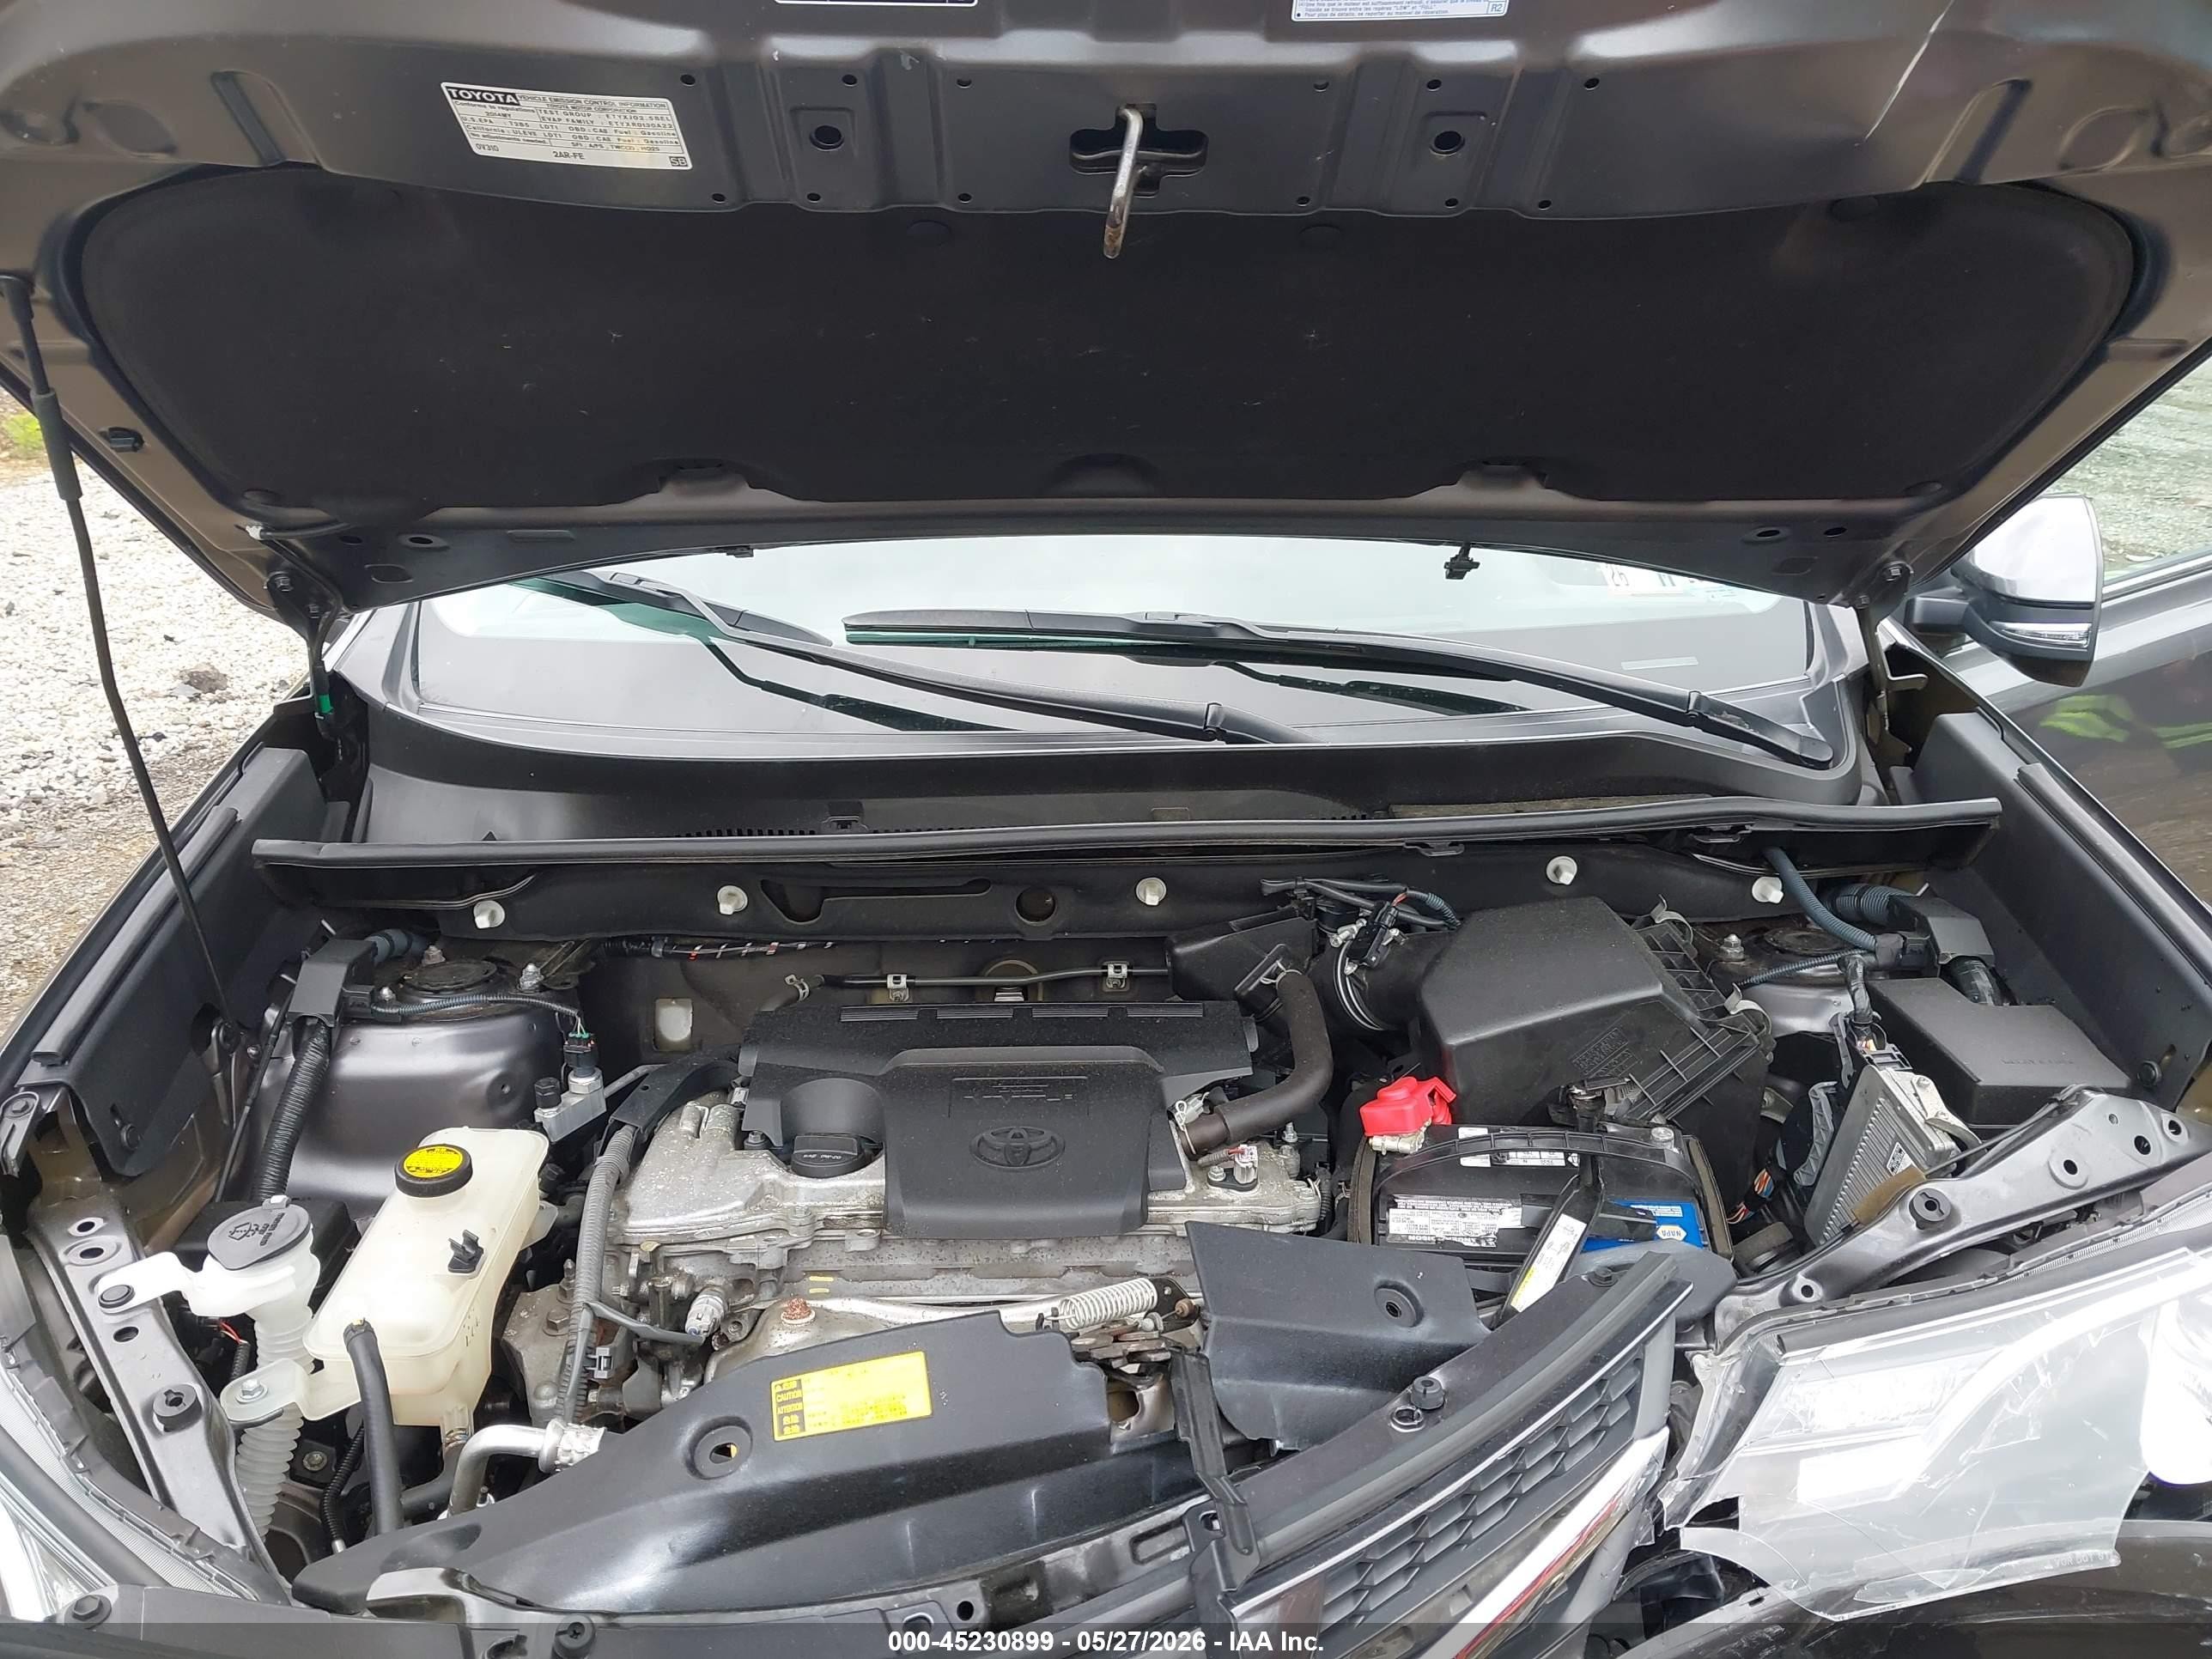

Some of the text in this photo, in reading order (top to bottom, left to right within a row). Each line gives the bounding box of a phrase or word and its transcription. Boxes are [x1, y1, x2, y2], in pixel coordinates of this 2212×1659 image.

[1491, 3, 1503, 12] R2
[447, 88, 520, 104] TOYOTA
[552, 150, 586, 160] 2AR-FE
[671, 157, 687, 166] SB
[1661, 1229, 1682, 1237] NAPA
